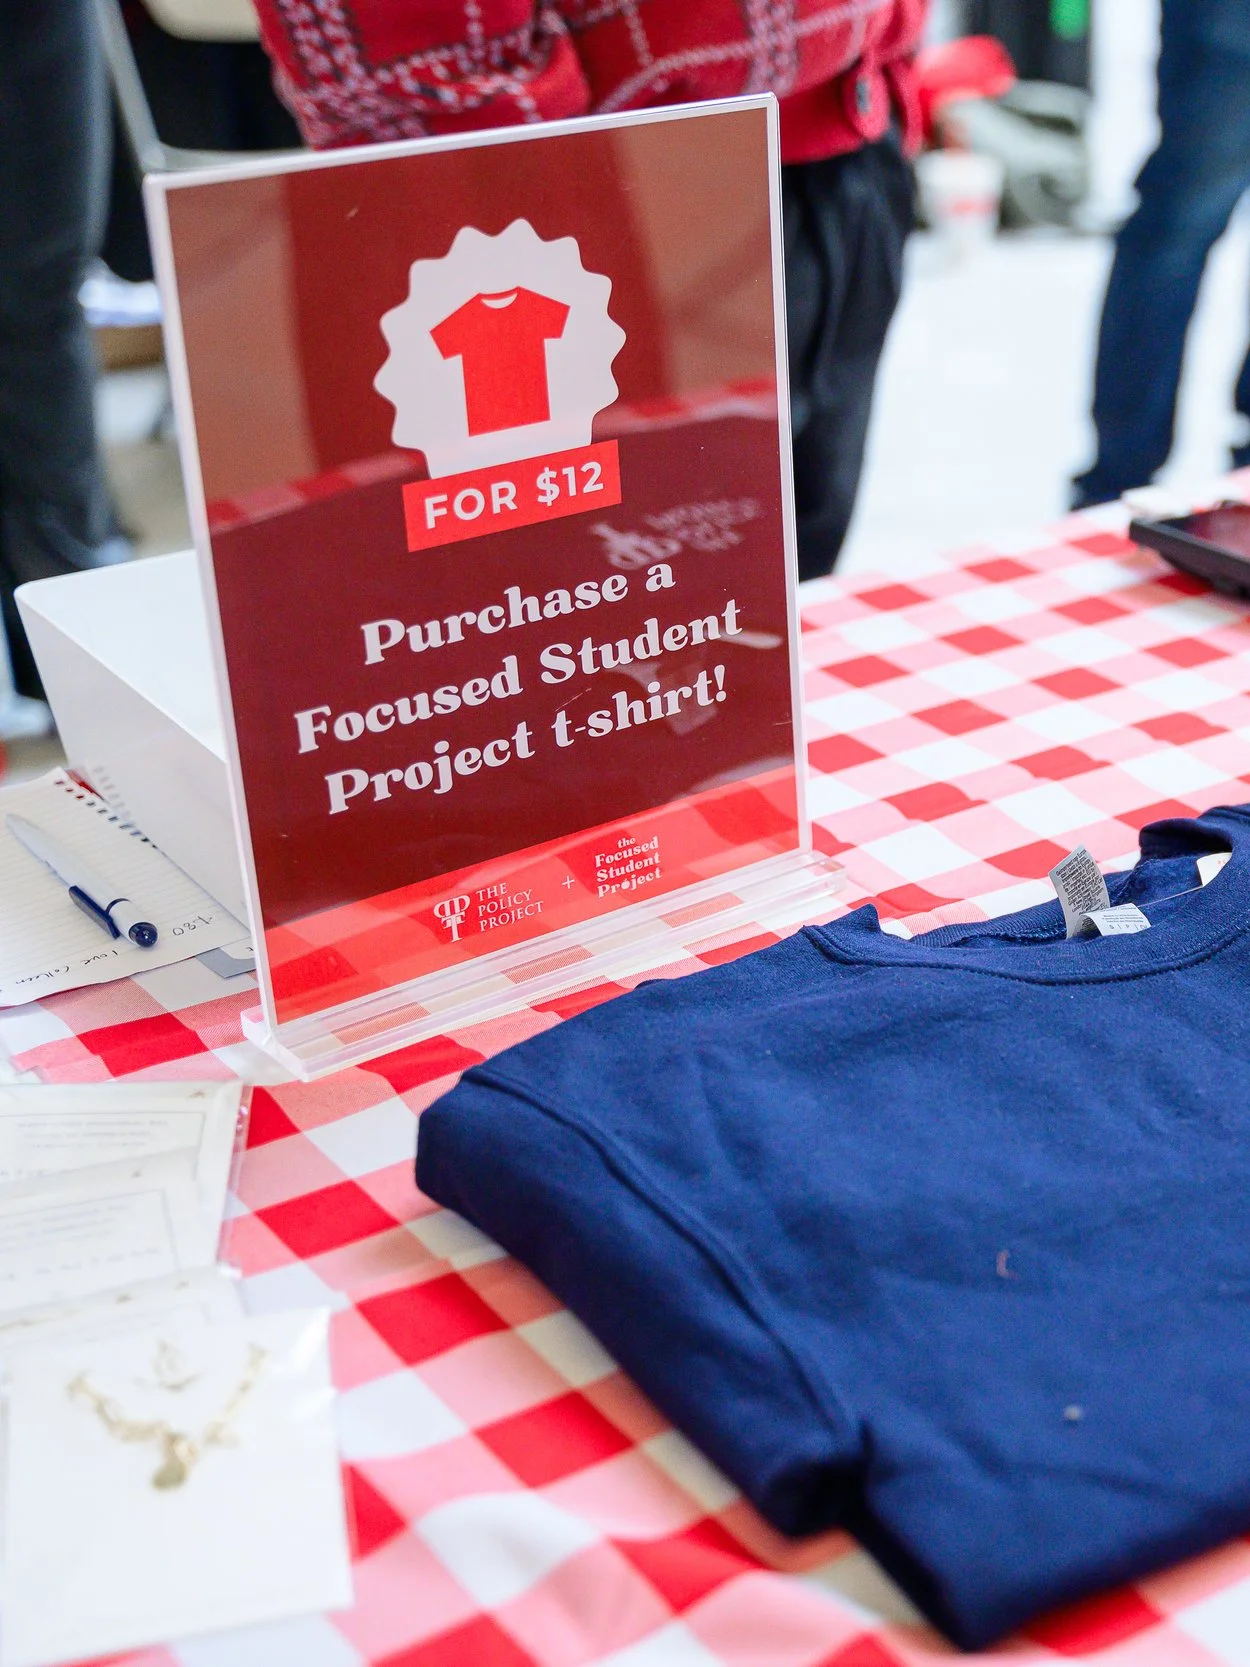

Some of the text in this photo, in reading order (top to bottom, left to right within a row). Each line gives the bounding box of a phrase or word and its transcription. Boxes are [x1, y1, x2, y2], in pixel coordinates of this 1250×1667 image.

[423, 460, 604, 529] FOR $12
[361, 563, 676, 666] Purchase a
[293, 599, 743, 754] Focused Student
[324, 664, 728, 815] Project t-shirt!
[594, 836, 660, 868] Focused
[617, 837, 637, 849] the
[596, 852, 661, 883] Student
[597, 866, 662, 899] Project
[476, 882, 508, 902] THE
[477, 889, 534, 917] POLICY
[479, 900, 545, 933] PROJECT
